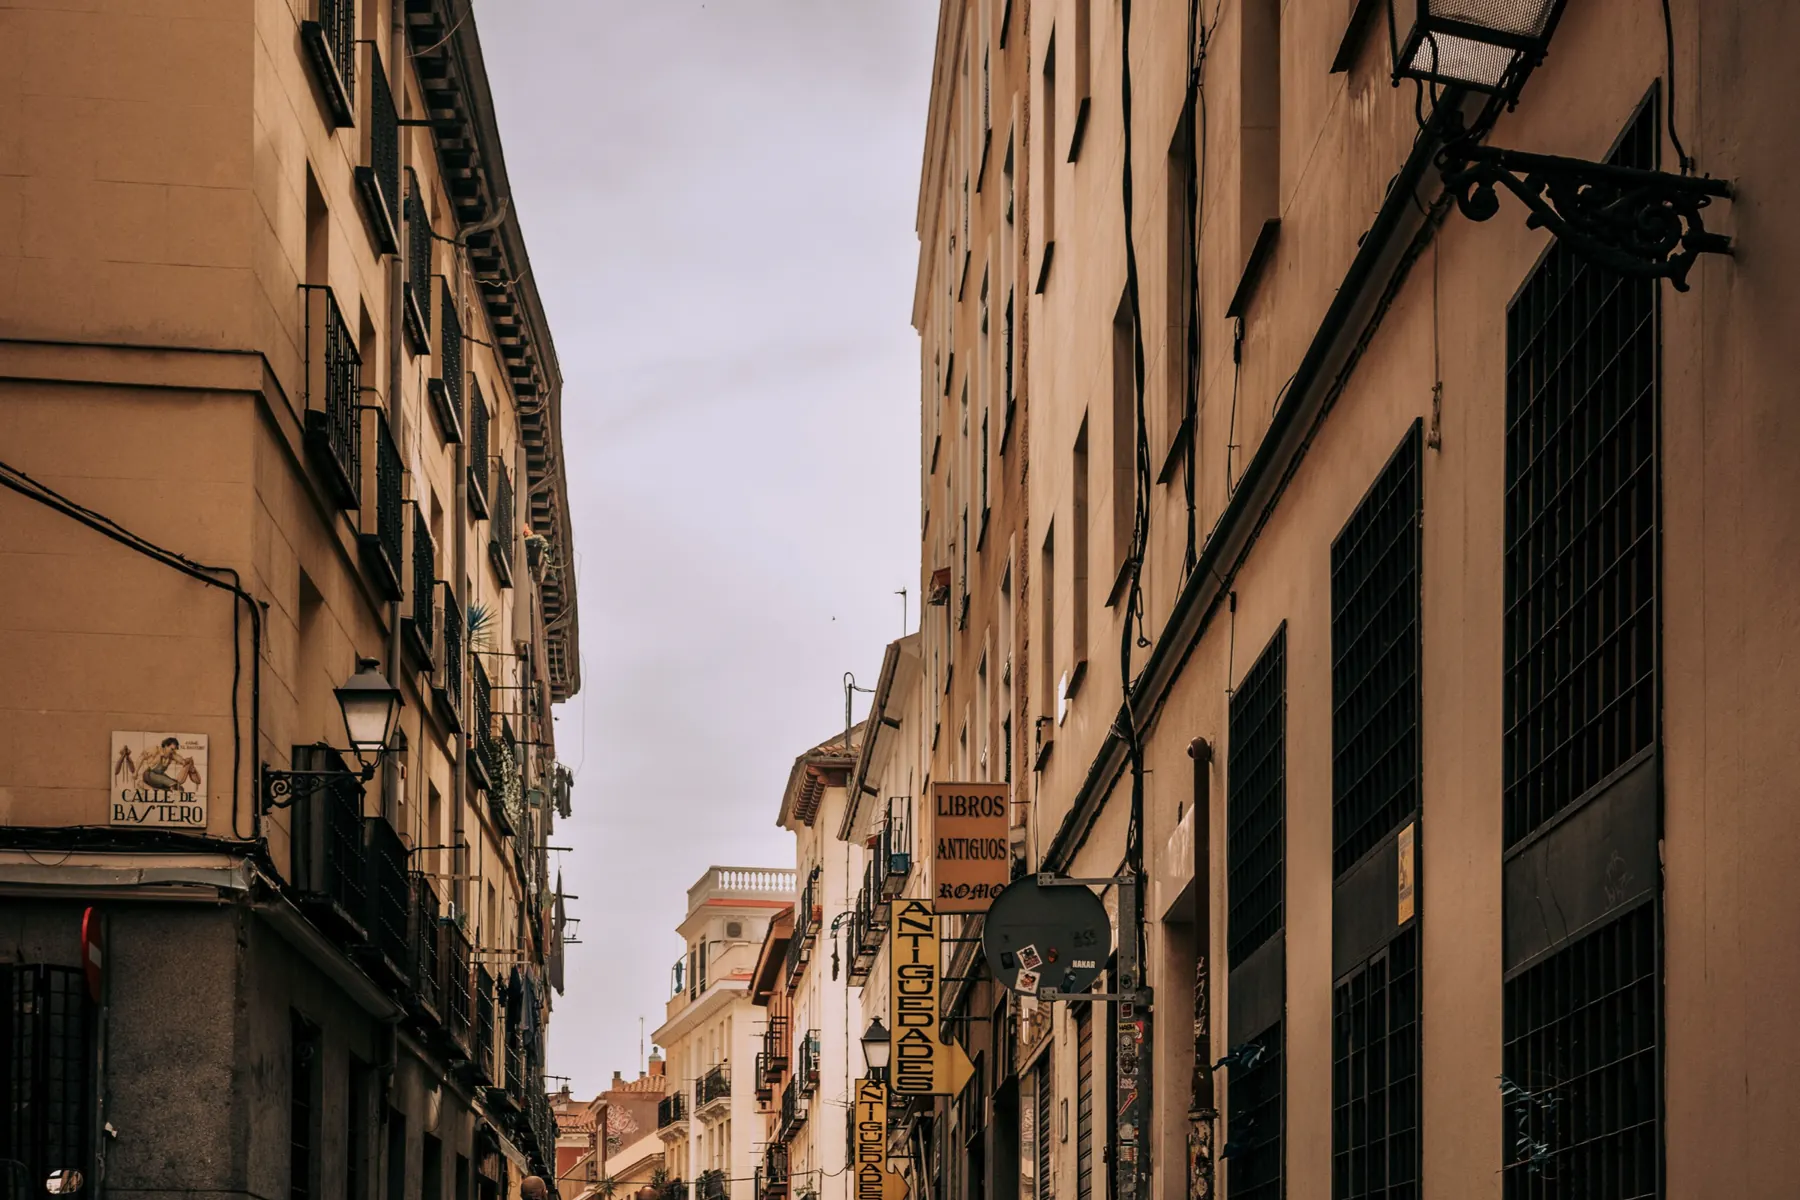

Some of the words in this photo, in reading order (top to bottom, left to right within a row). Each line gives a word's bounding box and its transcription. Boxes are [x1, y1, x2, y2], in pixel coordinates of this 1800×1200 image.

[122, 788, 175, 804] CALLE
[179, 791, 197, 802] DE
[937, 795, 1004, 818] LIBROS
[113, 804, 203, 825] BASTERO
[937, 838, 1007, 860] ANTIGUOS
[897, 901, 934, 1091] ANTIGÜEDADES
